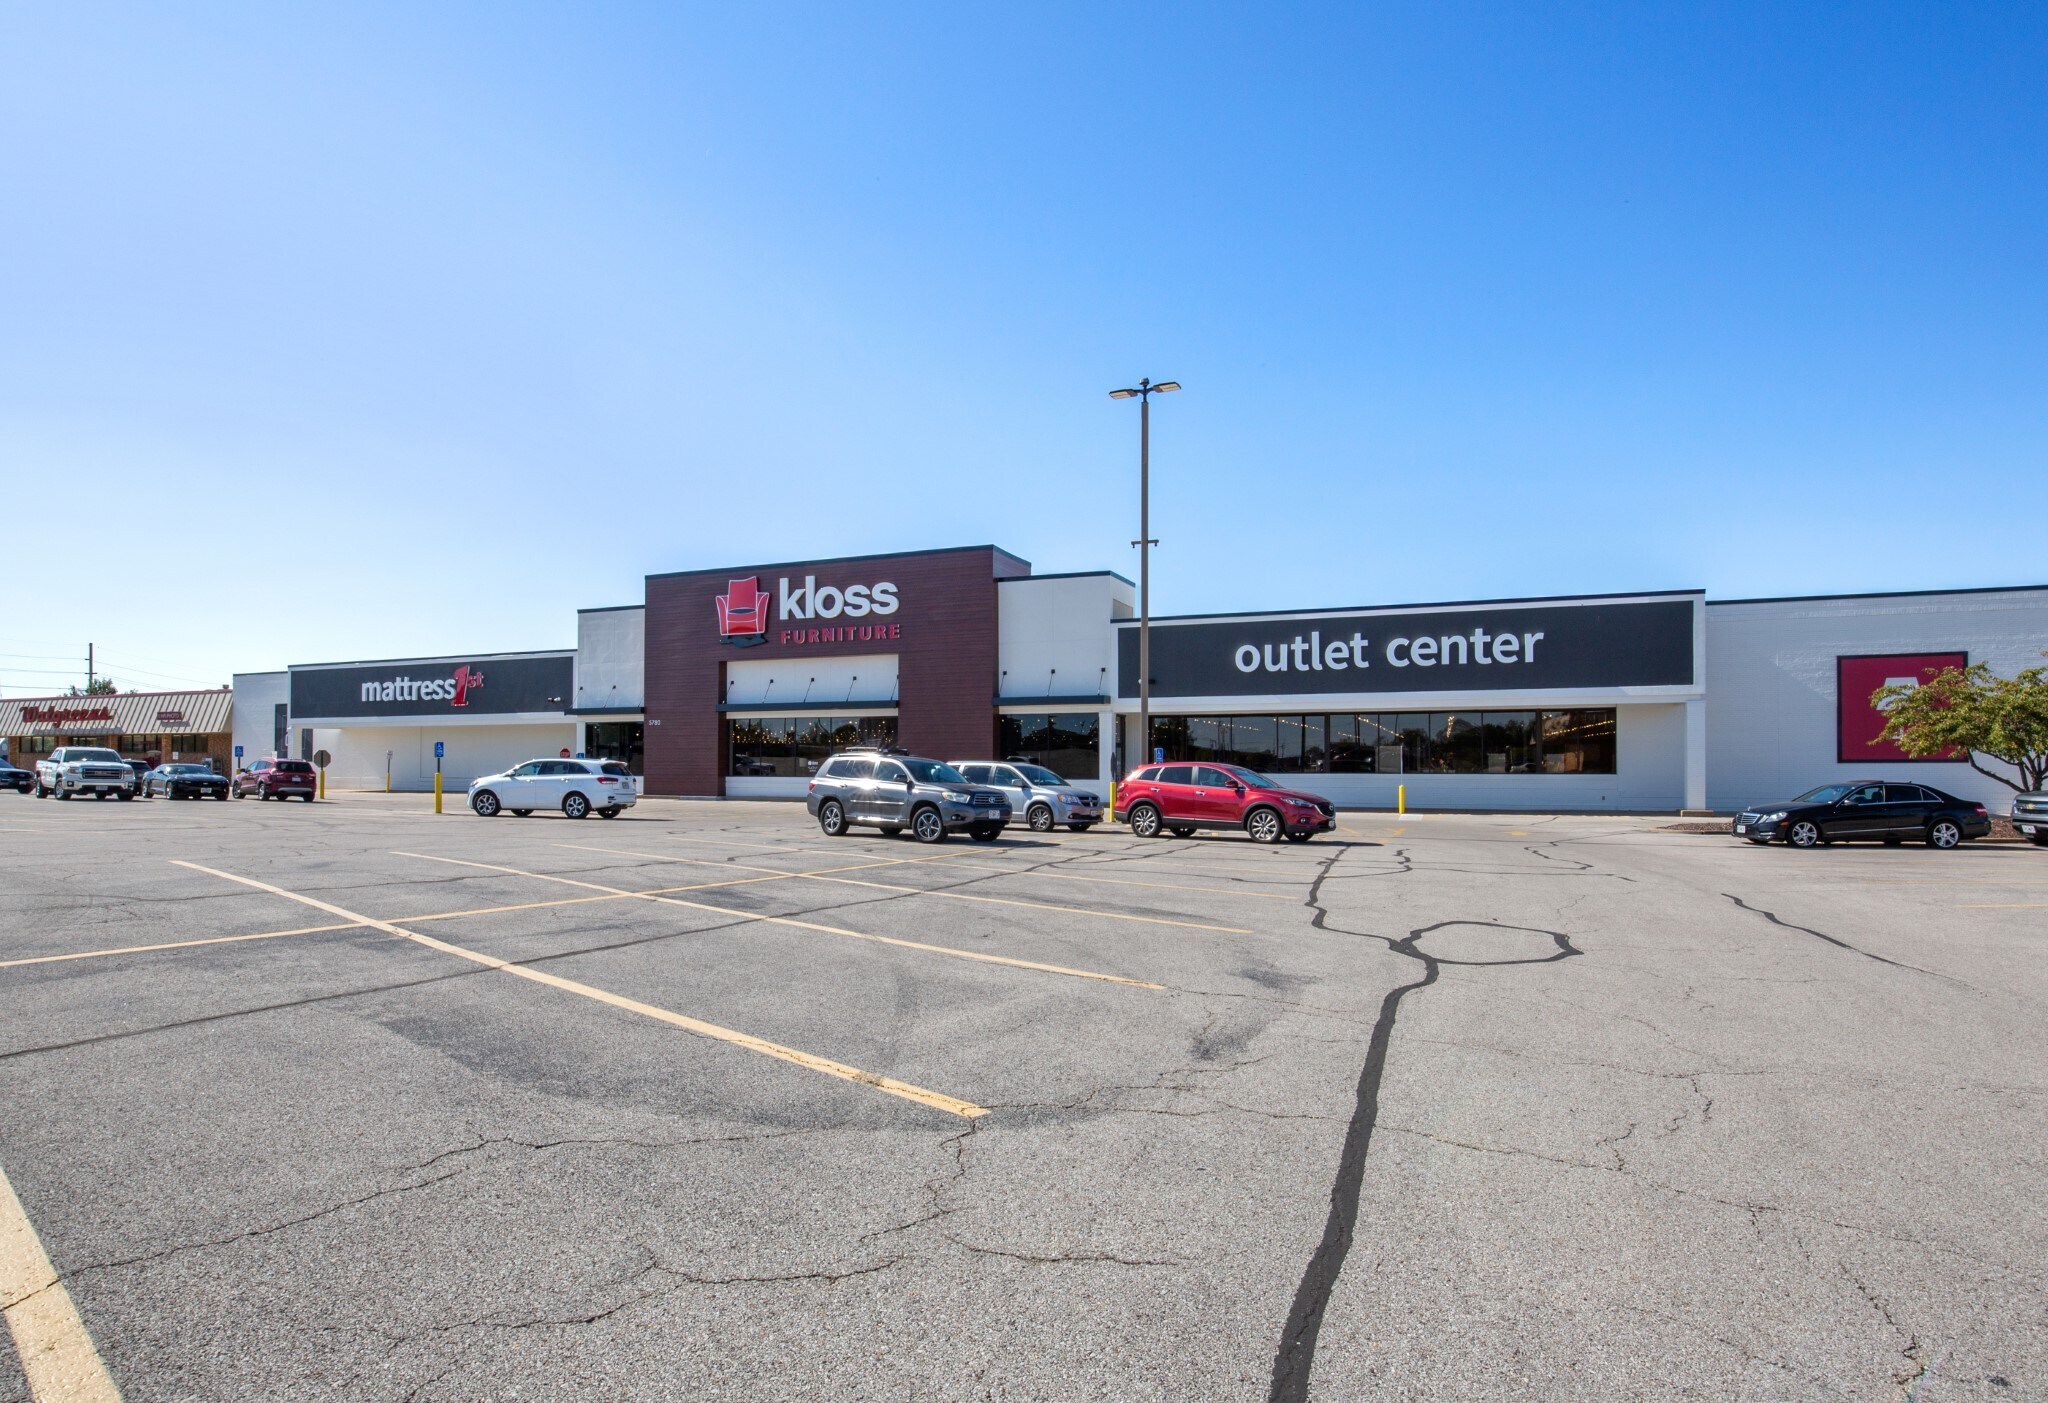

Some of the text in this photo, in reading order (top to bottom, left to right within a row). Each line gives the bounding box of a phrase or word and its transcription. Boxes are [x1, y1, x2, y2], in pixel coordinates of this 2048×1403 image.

[779, 575, 900, 620] kloss
[780, 624, 900, 645] FURNITURE
[1235, 628, 1544, 673] outlet center
[20, 705, 114, 728] Walgreens
